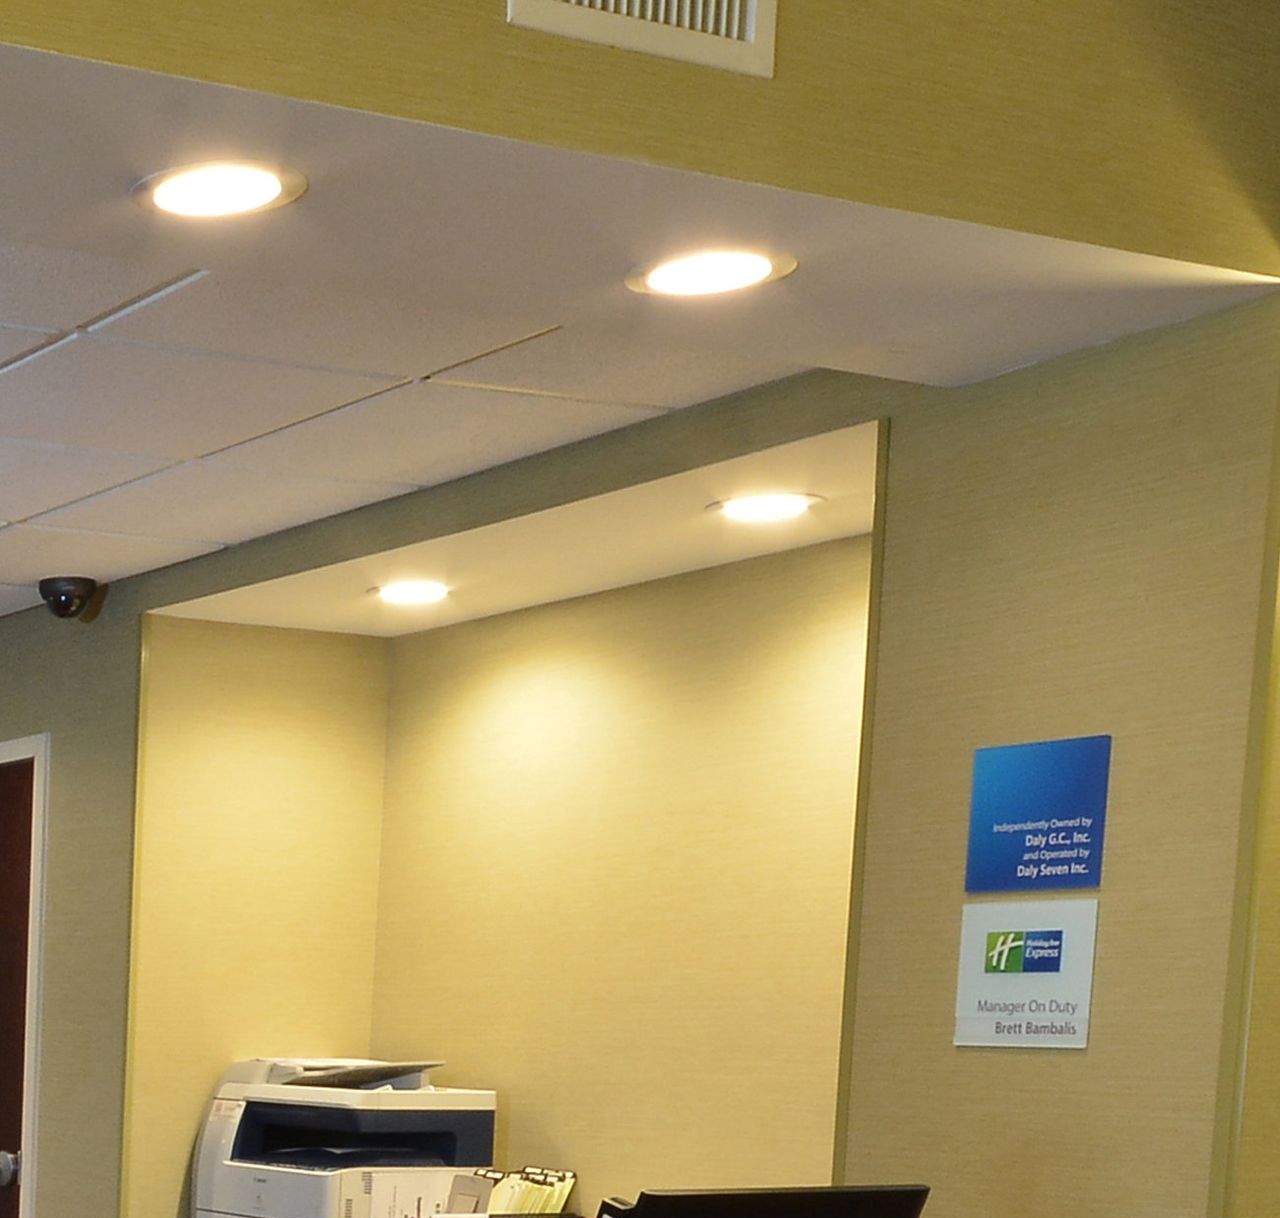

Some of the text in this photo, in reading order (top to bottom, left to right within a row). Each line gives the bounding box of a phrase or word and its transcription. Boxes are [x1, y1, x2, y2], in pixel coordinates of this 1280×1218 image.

[1050, 818, 1080, 828] Owned
[1081, 817, 1093, 828] by
[1025, 833, 1047, 848] Daly
[1073, 831, 1091, 843] Inc.
[1023, 847, 1090, 860] and Operated by
[1016, 862, 1089, 879] Daly Seven Inc.
[1025, 948, 1059, 960] Express
[977, 1000, 1078, 1016] Manager On Duty
[995, 1021, 1077, 1035] Brett Bambalis
